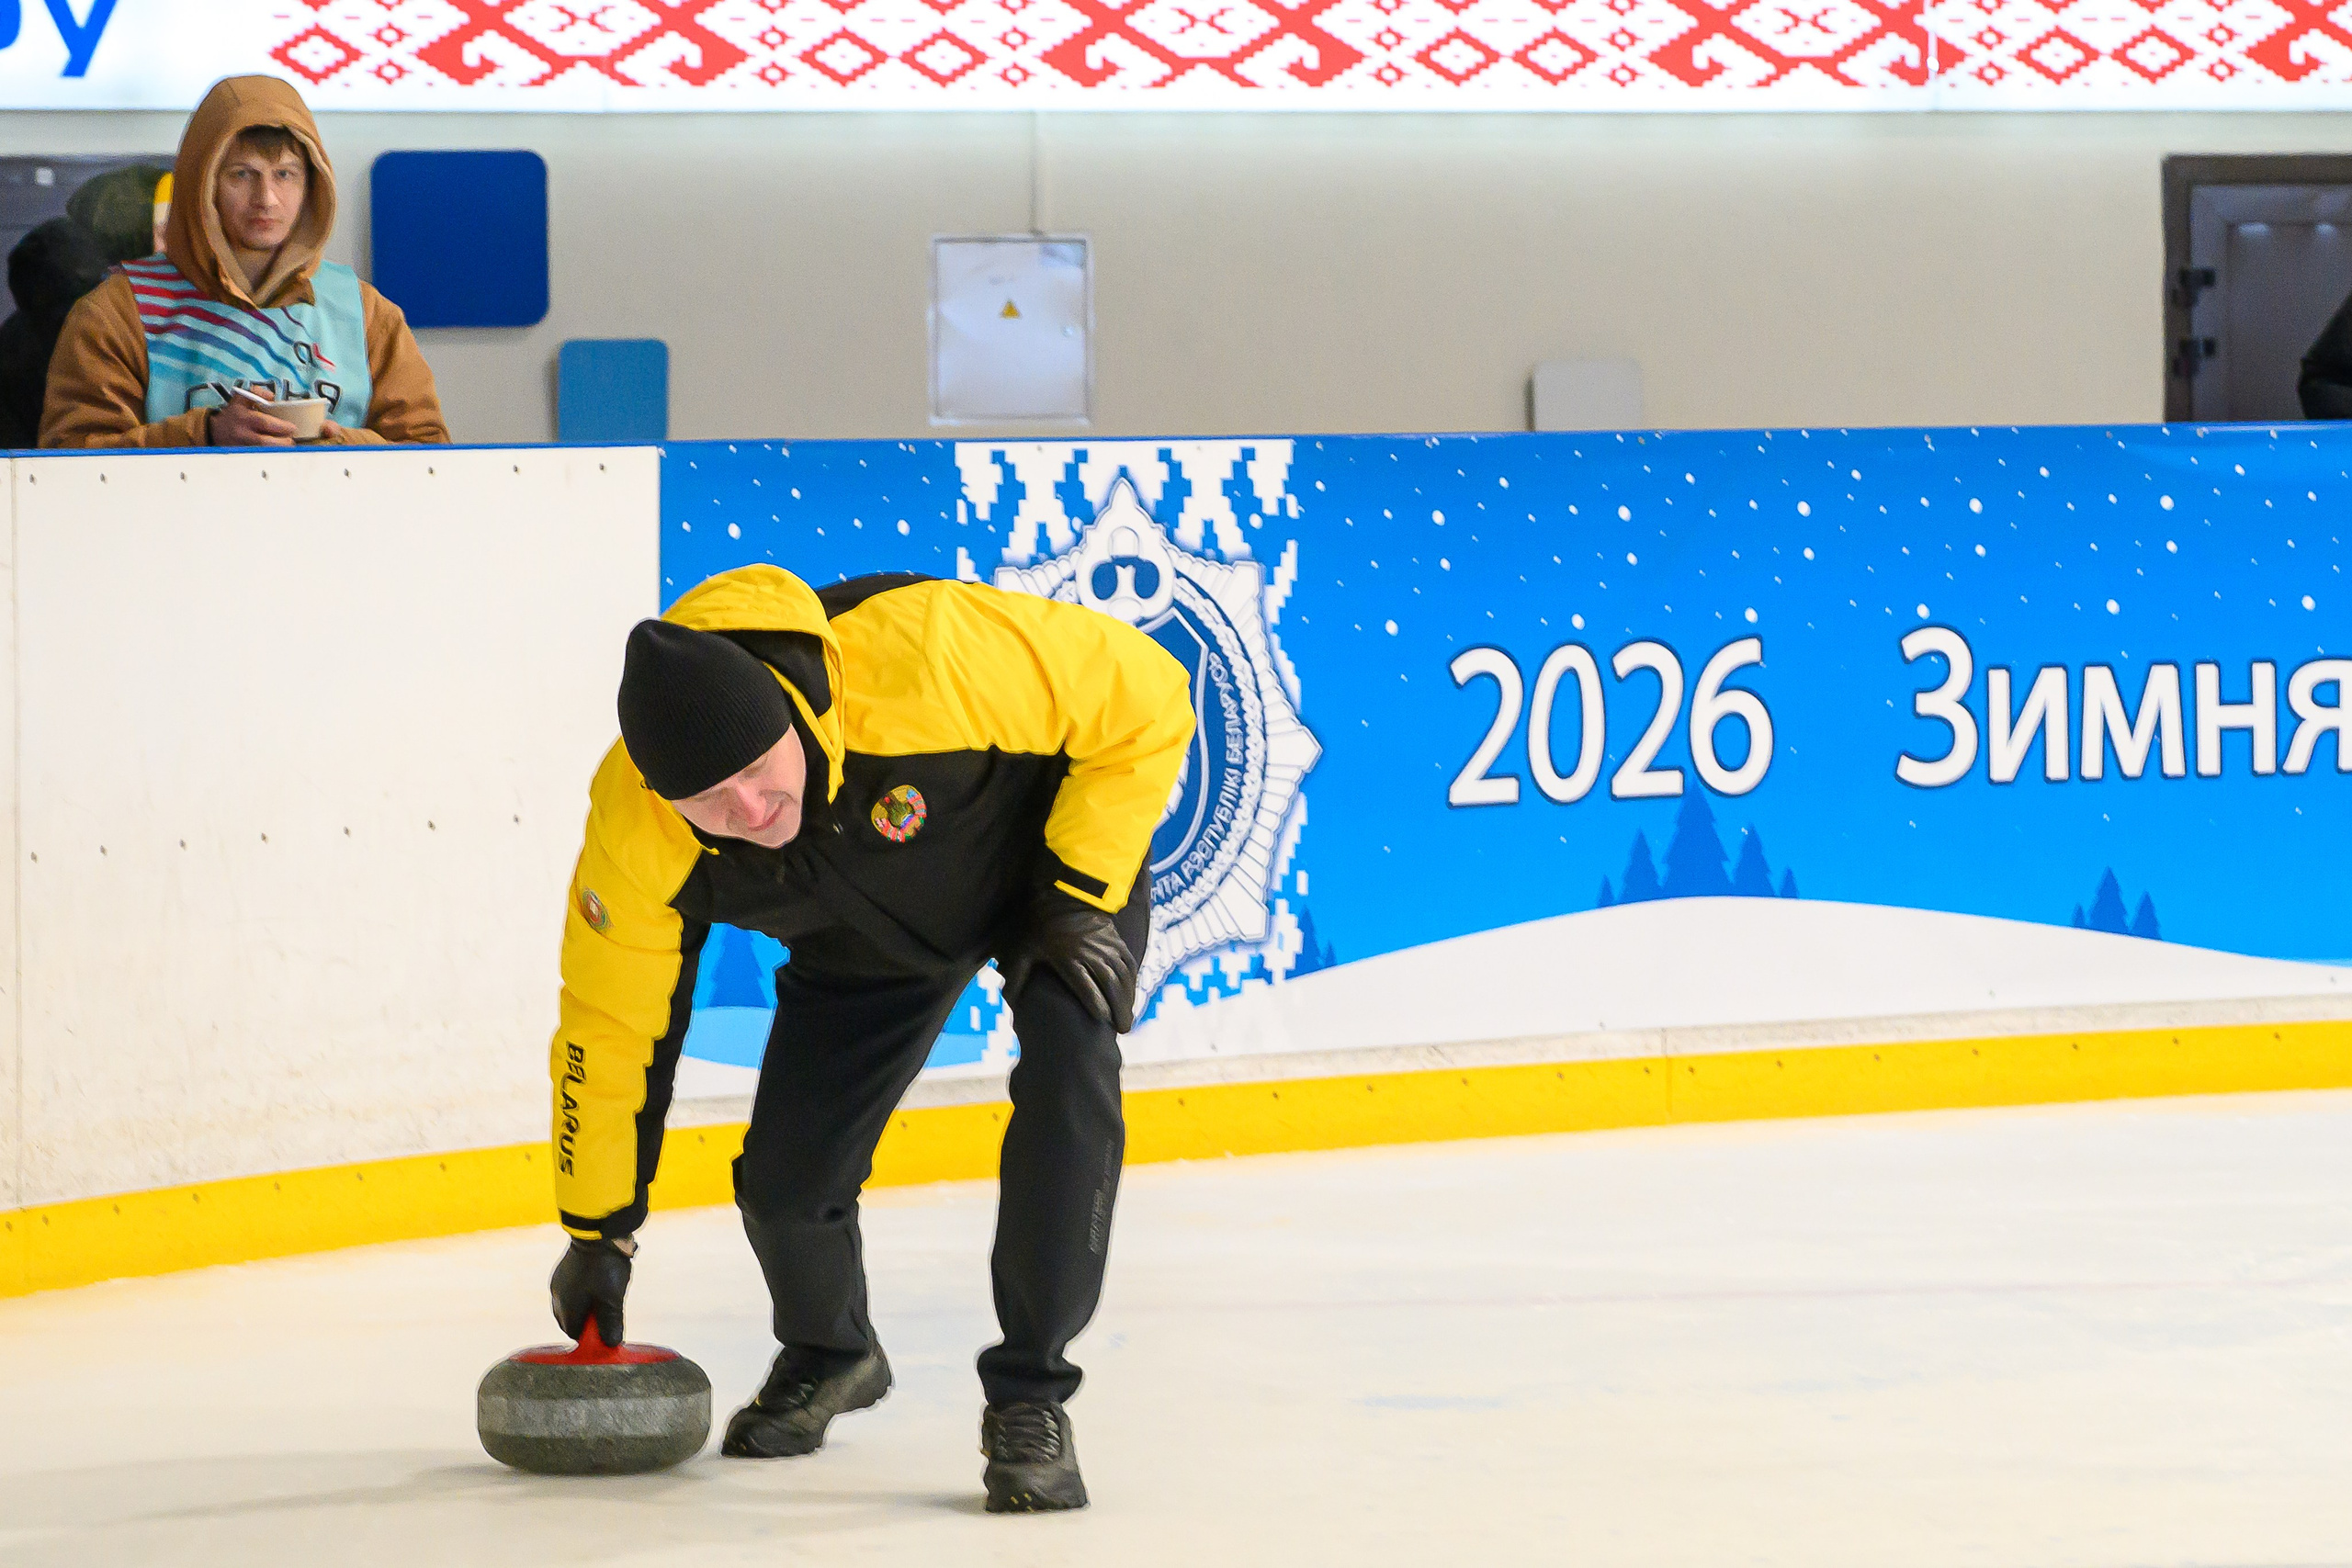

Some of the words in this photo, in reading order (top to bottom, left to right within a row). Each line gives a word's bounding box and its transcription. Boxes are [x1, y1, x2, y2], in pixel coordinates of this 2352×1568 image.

[1208, 651, 1244, 764] БЕЛАРУСЬ
[1447, 635, 1775, 808] 2026
[1894, 623, 2352, 789] Зимня
[560, 1041, 586, 1178] BELARUS
